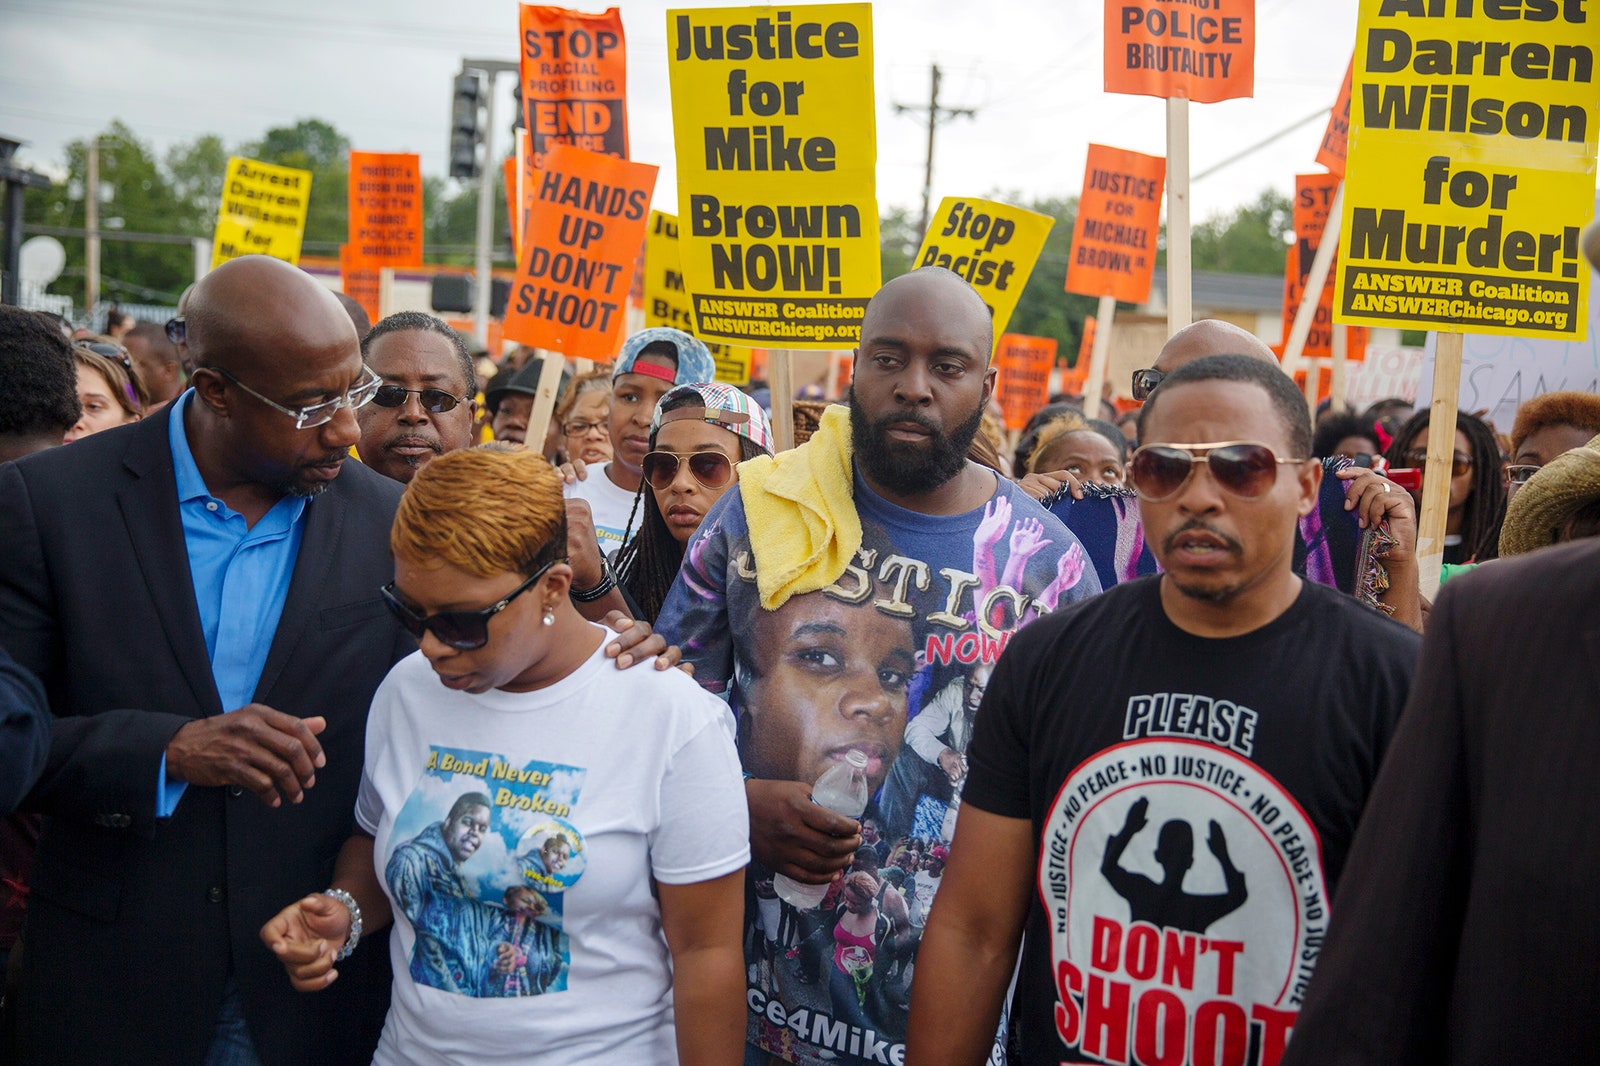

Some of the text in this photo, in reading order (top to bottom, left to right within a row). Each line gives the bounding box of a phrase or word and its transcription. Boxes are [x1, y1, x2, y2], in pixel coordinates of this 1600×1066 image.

[525, 29, 618, 59] STOP
[676, 11, 859, 61] Justice
[1121, 6, 1243, 44] POLICE
[540, 62, 599, 76] RACIAL
[1126, 43, 1232, 78] BRUTALITY
[1365, 28, 1594, 83] Darren
[530, 79, 616, 93] PROFILING
[727, 69, 804, 117] for
[535, 101, 611, 135] END
[1361, 83, 1588, 143] Wilson
[704, 126, 836, 172] Mike
[540, 170, 647, 221] HANDS
[1090, 169, 1157, 202] JUSTICE
[1300, 186, 1334, 208] ST
[1423, 156, 1517, 210] for
[690, 194, 861, 238] Brown
[941, 202, 1016, 252] Stop
[1104, 200, 1134, 216] FOR
[559, 214, 604, 250] UP
[1083, 218, 1147, 249] MICHAEL
[1349, 207, 1580, 279] Murder!
[528, 247, 623, 294] DON'T
[711, 243, 842, 295] NOW!
[1352, 272, 1570, 305] ANSWER Coalition
[516, 284, 618, 333] SHOOT
[699, 299, 865, 321] ANSWER Coalition
[1350, 294, 1568, 329] ANSWERChicago.org
[1123, 693, 1258, 758] PLEASE
[426, 751, 553, 787] A Bond Never
[1079, 760, 1129, 803] PEACE
[1140, 755, 1167, 777] NO
[1173, 757, 1246, 798] JUSTICE
[494, 787, 571, 818] Broken
[1063, 793, 1082, 823] NO
[1250, 794, 1282, 826] NO
[1049, 829, 1068, 901] JUSTICE
[1273, 821, 1314, 885] PEACE
[1057, 906, 1067, 934] NO
[1304, 891, 1324, 921] NO
[1090, 914, 1245, 997] DON'T
[1053, 957, 1299, 1066] SHOOT
